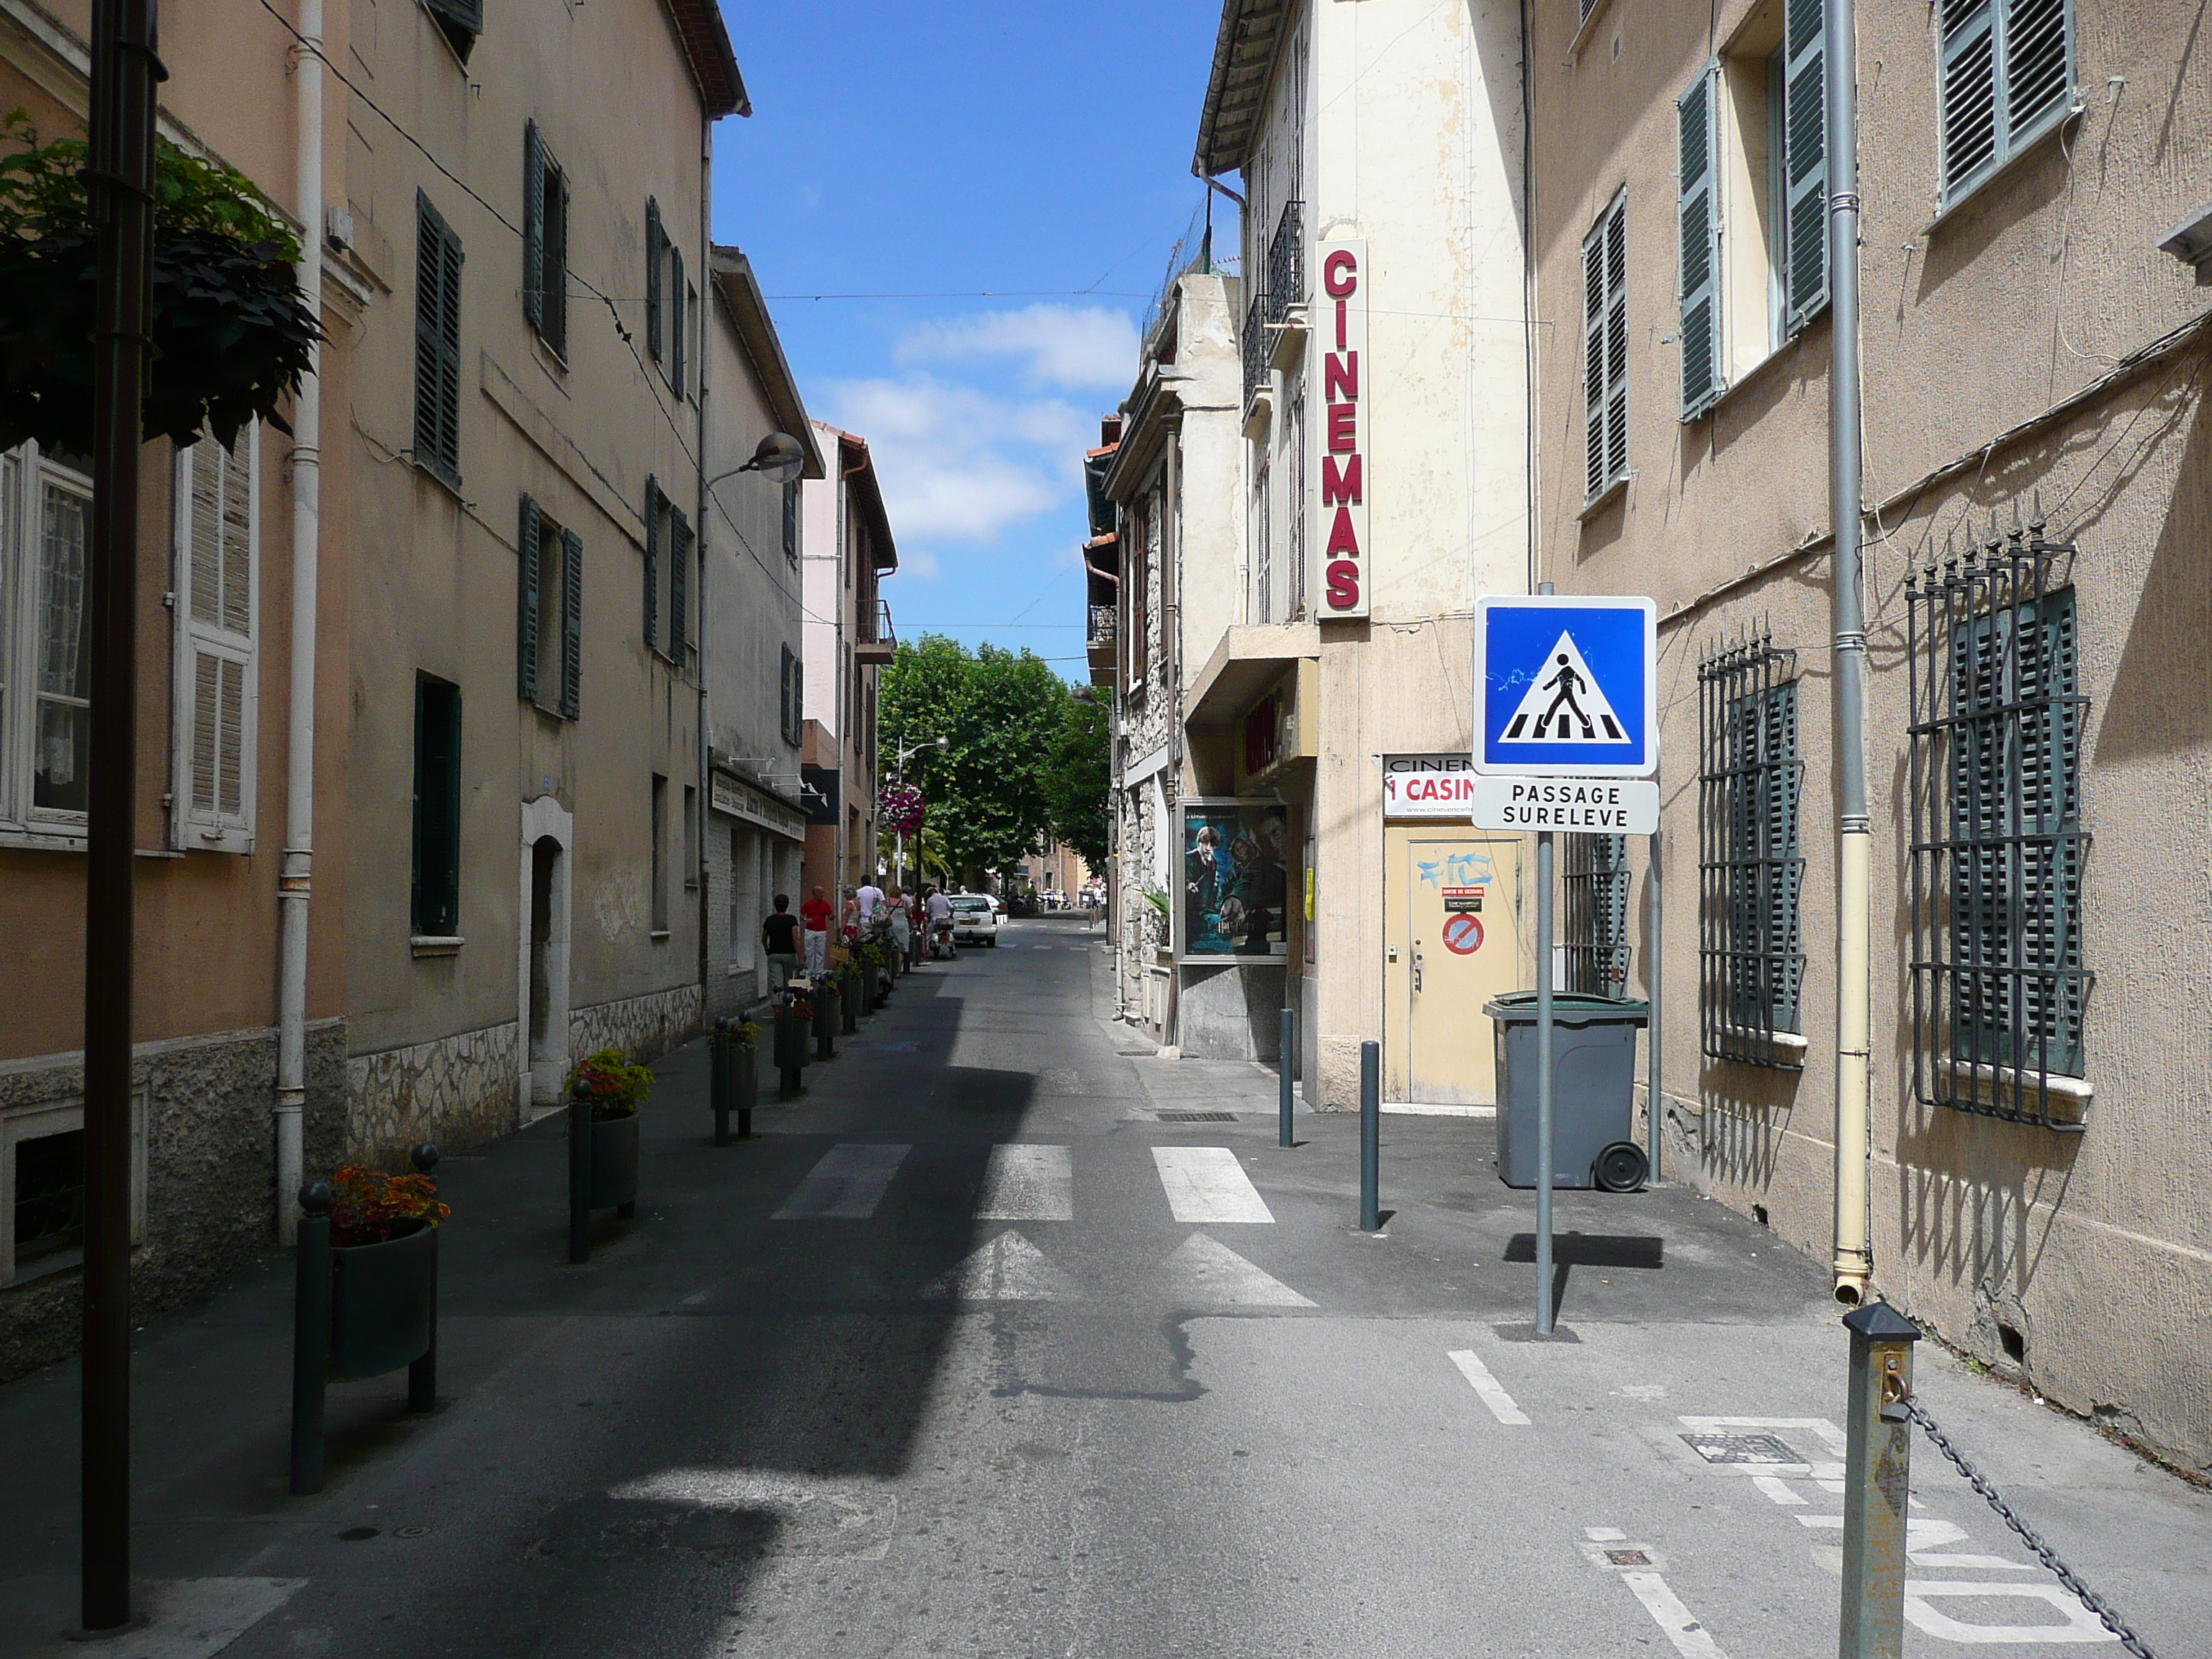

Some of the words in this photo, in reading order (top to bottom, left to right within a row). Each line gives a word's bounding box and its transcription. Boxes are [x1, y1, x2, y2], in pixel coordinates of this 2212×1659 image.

[1322, 249, 1362, 608] CINEMAS
[1512, 785, 1620, 804] PASSAGE
[1503, 806, 1627, 827] SURELEVE
